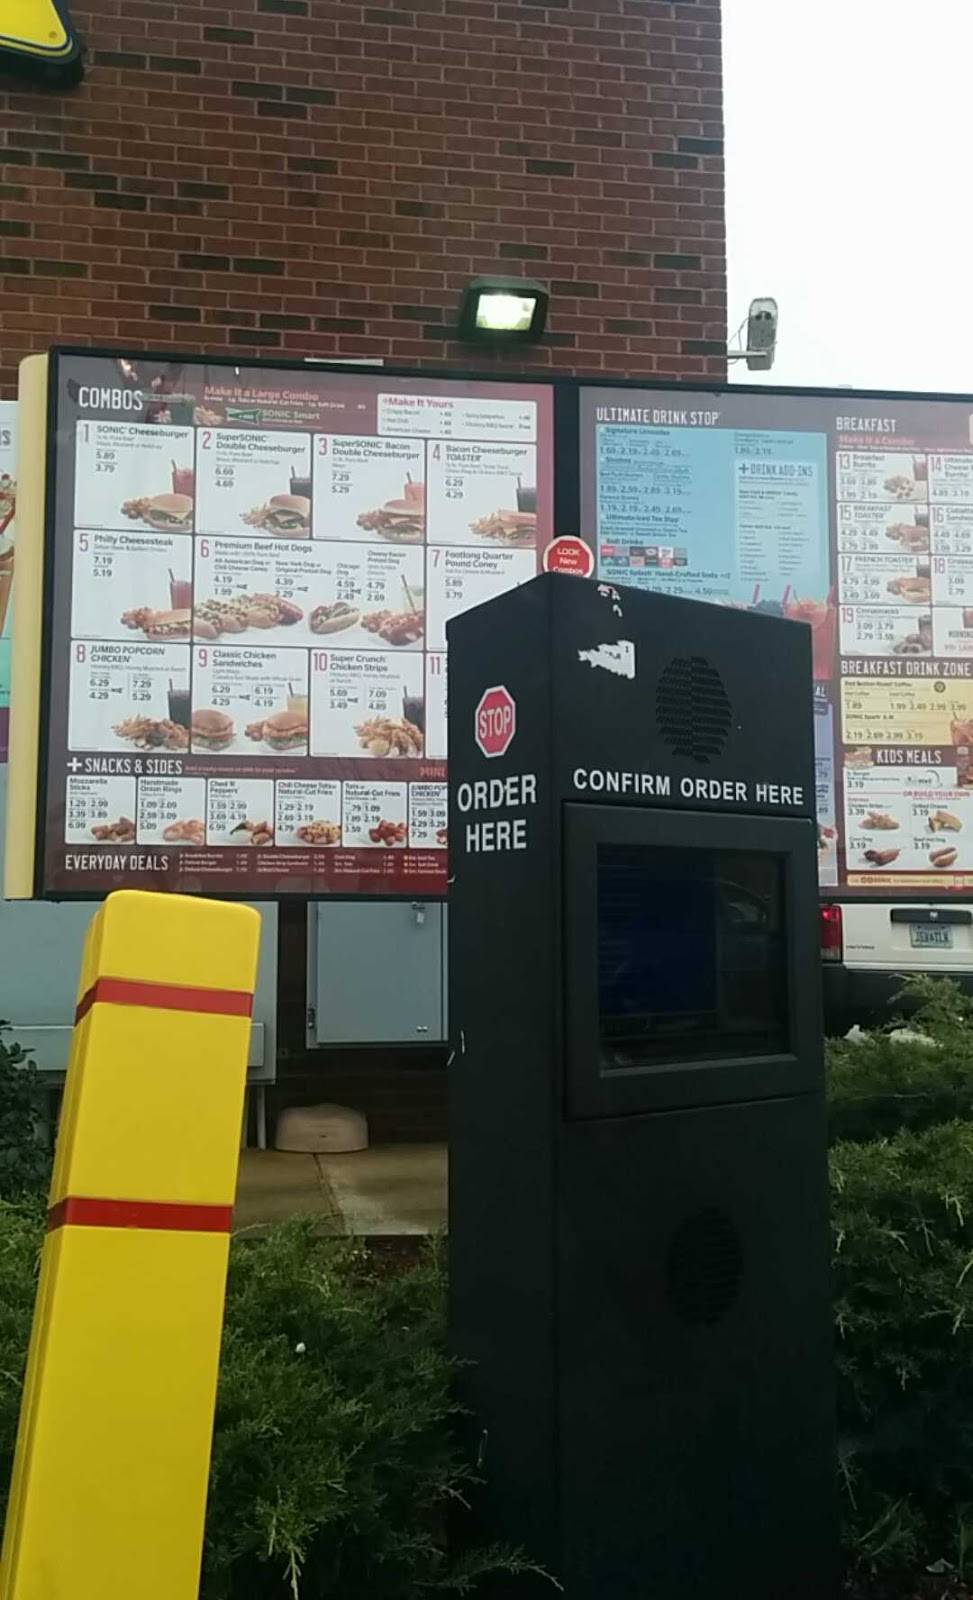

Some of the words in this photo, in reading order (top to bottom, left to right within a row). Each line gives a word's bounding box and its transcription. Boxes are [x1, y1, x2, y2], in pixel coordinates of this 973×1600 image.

[79, 387, 143, 410] COMBOS
[204, 386, 233, 396] Make
[252, 388, 280, 400] Large
[282, 390, 319, 401] Combo
[426, 400, 454, 408] Yours
[262, 409, 290, 418] SONIC
[293, 410, 321, 420] Smart
[596, 407, 650, 423] ULTIMATE
[653, 409, 687, 425] DRINK
[690, 411, 719, 426] STOP
[836, 416, 896, 433] BREAKFAST
[83, 423, 90, 443] 1
[128, 426, 189, 440] Cheeseburger
[216, 432, 267, 443] SuperSONIC
[202, 431, 212, 450] 2
[318, 437, 328, 456] 3
[332, 438, 382, 450] SuperSONIC
[385, 441, 411, 451] Bacon
[216, 442, 246, 451] Double
[247, 443, 306, 455] Cheeseburger
[332, 448, 361, 457] Double
[362, 448, 420, 460] Cheeseburger
[432, 443, 442, 461] 4
[445, 444, 471, 454] Bacon
[471, 445, 528, 457] Cheeseburger
[839, 453, 850, 470] 13
[931, 456, 942, 472] 14
[750, 463, 776, 476] DRINK
[332, 473, 350, 482] 7.29
[445, 478, 464, 487] 6.29
[331, 486, 350, 494] 5.29
[445, 491, 464, 499] 4.29
[840, 504, 852, 521] 15
[931, 506, 945, 523] 16
[79, 533, 89, 553] 5
[94, 534, 120, 545] Philly
[119, 535, 174, 546] Cheesesteak
[200, 538, 210, 558] 6
[214, 541, 253, 550] Premium
[253, 541, 273, 551] Beef
[274, 542, 290, 552] Hot
[290, 543, 312, 553] Dogs
[93, 556, 113, 565] 7.19
[432, 549, 441, 568] 7
[445, 551, 481, 561] Footlong
[482, 552, 514, 561] Quarter
[559, 557, 578, 565] New
[445, 559, 472, 569] Pound
[472, 560, 498, 570] Coney
[840, 555, 853, 572] 17
[933, 557, 946, 575] 18
[93, 568, 113, 577] 5.19
[214, 576, 233, 584] 4.19
[366, 581, 385, 590] 4.79
[841, 607, 854, 624] 19
[76, 643, 87, 664] 8
[90, 645, 121, 655] JUMBO
[122, 646, 165, 656] POPCORN
[212, 649, 242, 659] Classic
[242, 651, 277, 660] Chicken
[90, 654, 131, 664] CHICKEN
[198, 648, 209, 668] 9
[212, 659, 264, 669] Sandwiches
[313, 652, 328, 672] 10
[330, 653, 355, 664] Super
[355, 655, 386, 664] Crunch
[330, 662, 363, 672] Chicken
[364, 663, 389, 674] Strips
[430, 656, 441, 675] 11
[841, 660, 902, 676] BREAKFAST
[905, 661, 941, 676] DRINK
[943, 661, 972, 677] ZONE
[132, 680, 152, 689] 7.29
[211, 685, 231, 694] 6.29
[254, 686, 274, 695] 6.19
[89, 692, 109, 700] 4.29
[132, 693, 152, 702] 5.29
[814, 685, 826, 698] AL
[211, 698, 231, 707] 4.29
[254, 699, 274, 708] 4.19
[479, 705, 512, 739] STOP
[876, 748, 905, 765] KIDS
[906, 749, 942, 766] MEALS
[84, 757, 131, 774] SNACKS
[134, 759, 144, 774] &
[146, 759, 183, 776] SIDES
[70, 777, 108, 785] Mozzarella
[140, 779, 179, 787] Handmade
[210, 780, 229, 788] Ched
[293, 782, 318, 790] Cheese
[573, 767, 671, 796] CONFIRM
[680, 777, 748, 802] ORDER
[756, 783, 804, 806] HERE
[140, 785, 162, 793] Onion
[162, 786, 183, 794] Rings
[209, 788, 239, 796] Peppers
[278, 788, 317, 796] Natural-Cut
[317, 789, 334, 797] Fries
[345, 789, 384, 797] Natural-Cut
[384, 790, 401, 798] Fries
[410, 790, 442, 798] CHICKEN
[458, 773, 537, 813] ORDER
[912, 809, 929, 817] 3.19
[466, 819, 528, 853] HERE
[849, 842, 867, 850] 3.19
[913, 843, 931, 851] 3.19
[65, 854, 128, 871] EVERYDAY
[129, 855, 169, 871] DEALS
